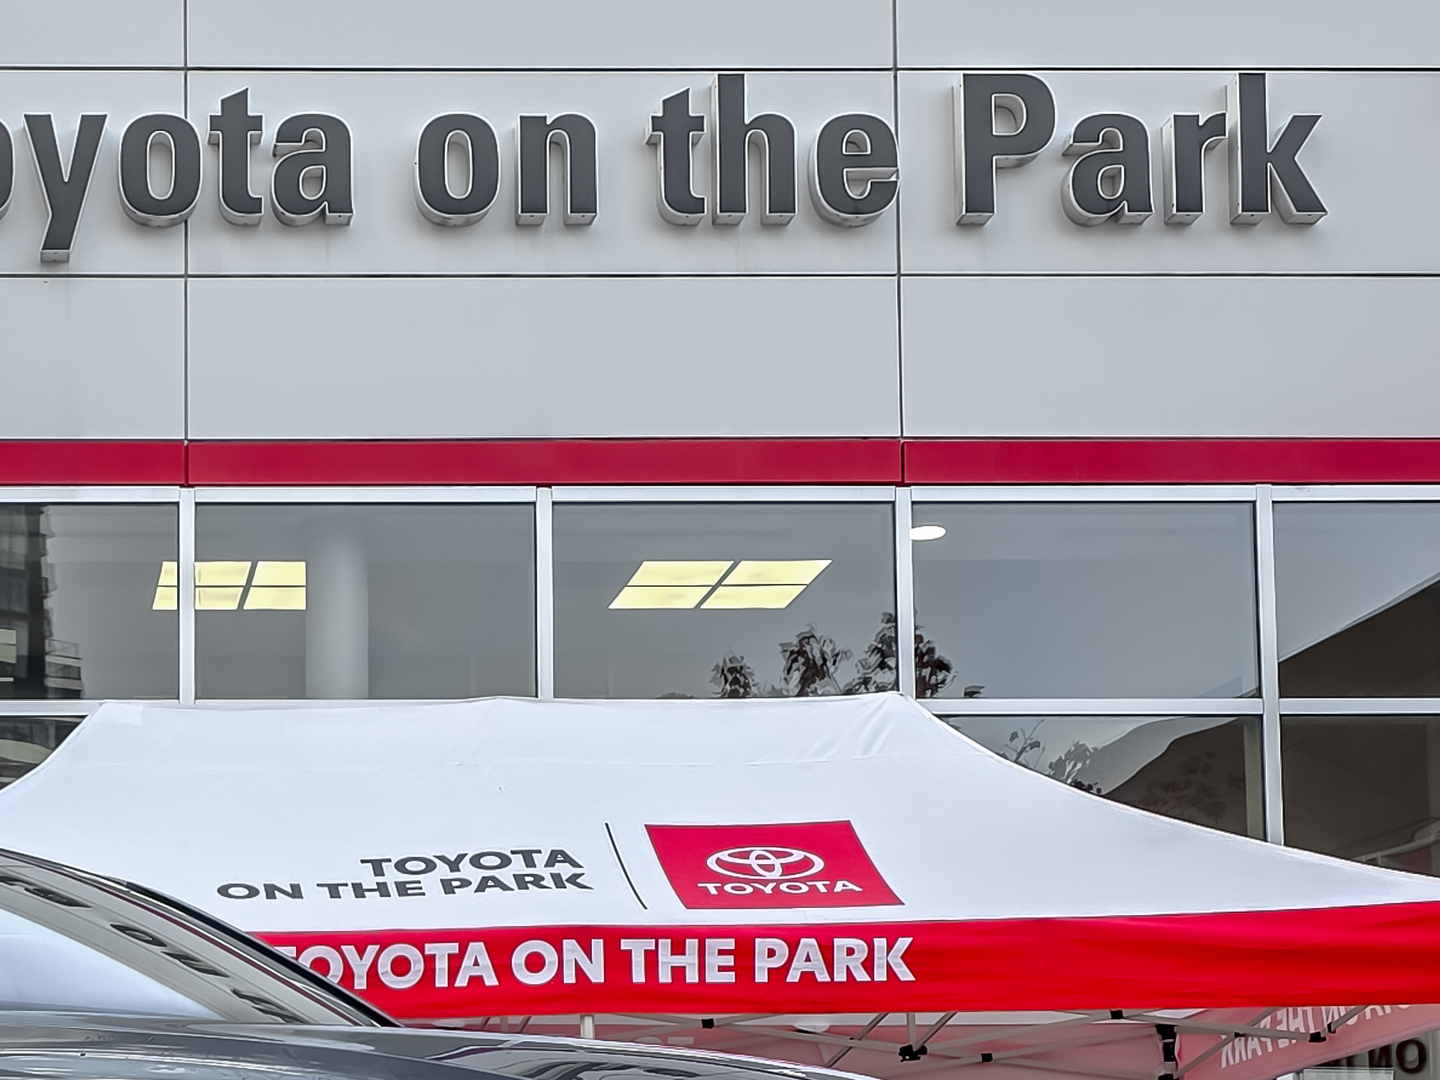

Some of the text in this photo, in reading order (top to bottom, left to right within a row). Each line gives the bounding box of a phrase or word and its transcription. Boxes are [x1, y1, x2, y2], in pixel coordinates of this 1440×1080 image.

[415, 112, 597, 227] on
[646, 72, 899, 227] the
[951, 71, 1327, 226] Park
[360, 849, 584, 877] TOYOTA
[216, 872, 595, 900] ON THE PARK
[697, 880, 863, 895] TOYOTA
[273, 936, 916, 990] OYOTA ON THE PARK
